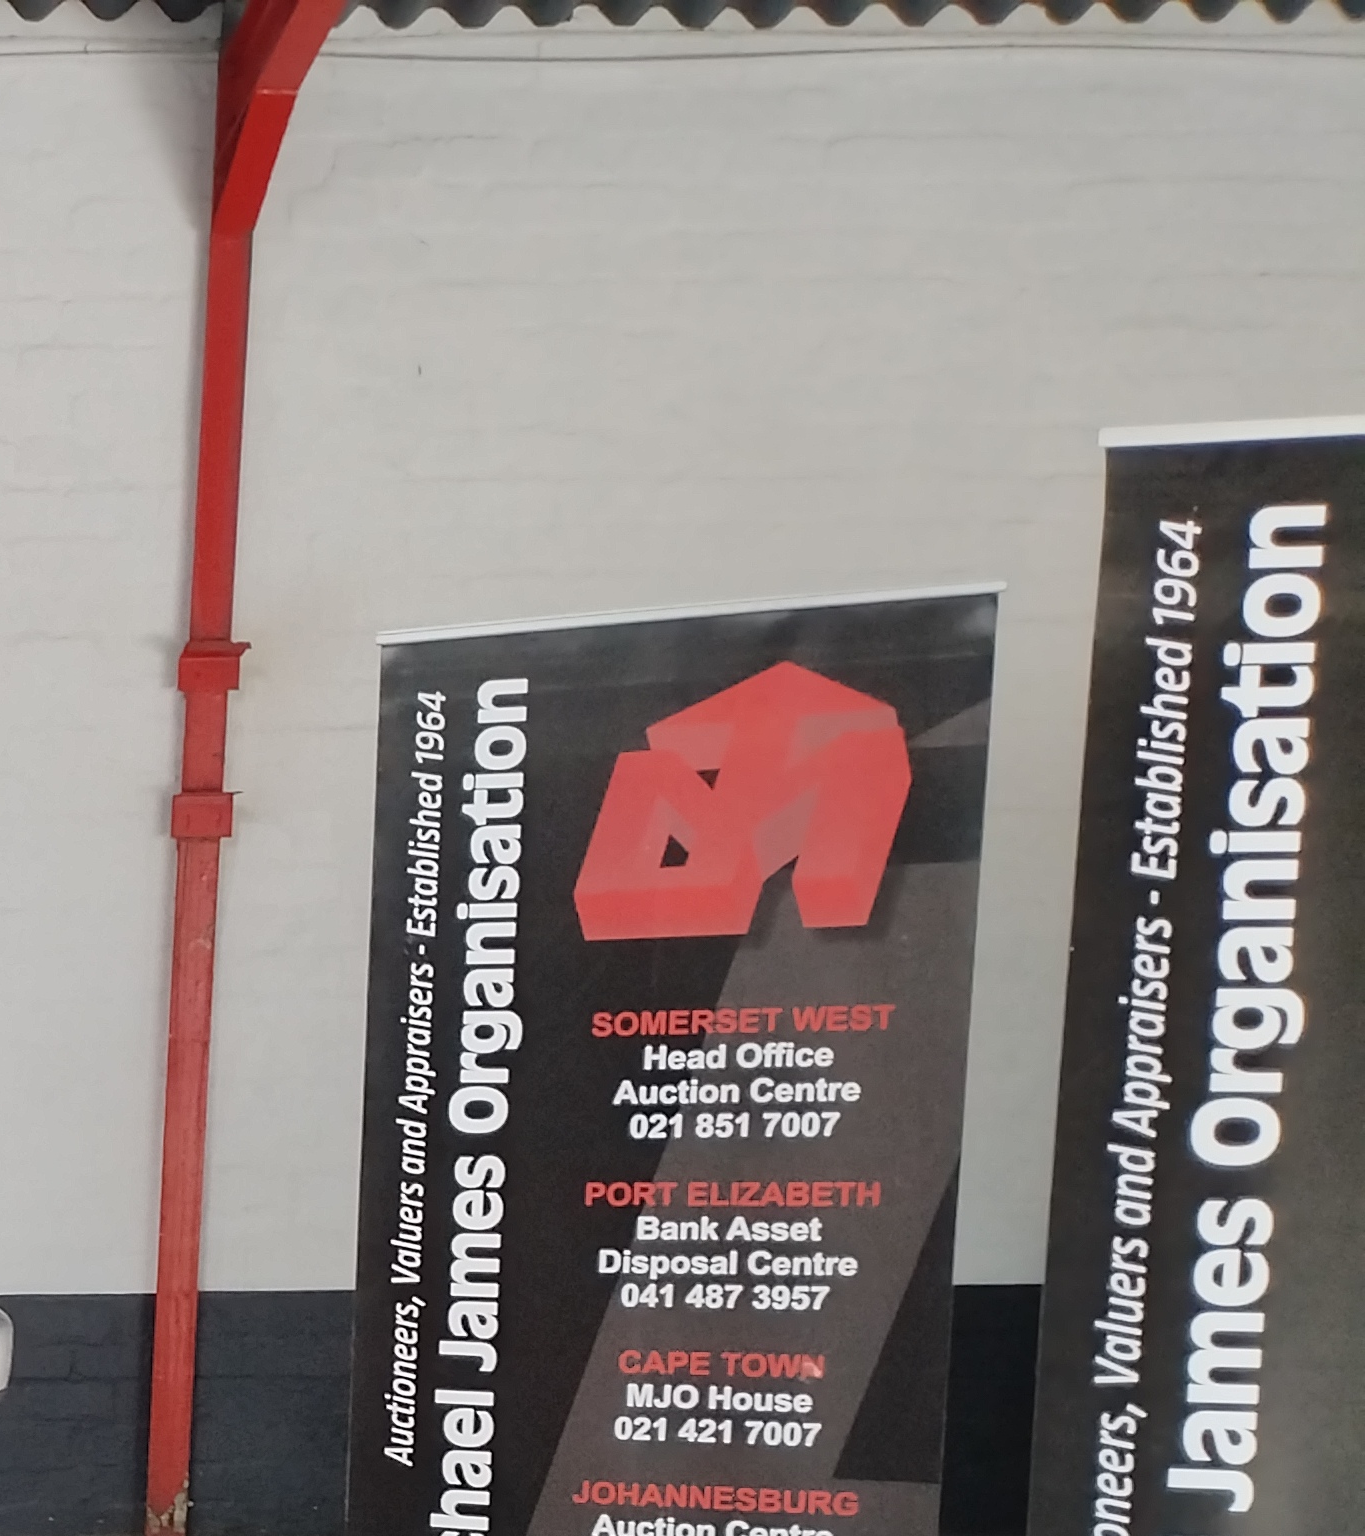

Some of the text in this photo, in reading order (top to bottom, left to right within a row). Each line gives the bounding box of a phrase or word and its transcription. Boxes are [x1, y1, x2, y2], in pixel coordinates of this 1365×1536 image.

[1151, 519, 1203, 625] 1964
[414, 690, 447, 764] 1964
[1130, 635, 1193, 880] Established
[405, 771, 443, 938] Established
[1189, 504, 1328, 1167] Organisation
[448, 677, 529, 1134] Organisation
[397, 961, 437, 1115] Appraisers
[591, 1004, 895, 1038] SOMERSET WEST
[642, 1041, 835, 1071] Head Office
[1111, 916, 1173, 1138] Appraisers
[612, 1076, 862, 1106] Auction Centre
[629, 1111, 841, 1140] 021 851 7007
[395, 1117, 427, 1175] and
[584, 1181, 881, 1208] PORT ELIZABETH
[1106, 1143, 1156, 1226] and
[389, 1181, 425, 1284] Valuers
[438, 1154, 506, 1373] James
[598, 1248, 859, 1281] Disposal Centre
[636, 1215, 823, 1242] Bank Asset
[620, 1282, 831, 1311] 041 487 3957
[1093, 1235, 1149, 1385] Valuers
[383, 1295, 427, 1467] Auctioneers,
[618, 1349, 825, 1378] CAPE TOWN
[1166, 1197, 1275, 1513] James
[613, 1415, 823, 1448] 021 421 7007
[626, 1382, 814, 1414] MJO House
[572, 1480, 859, 1517] JOHANNESBURG
